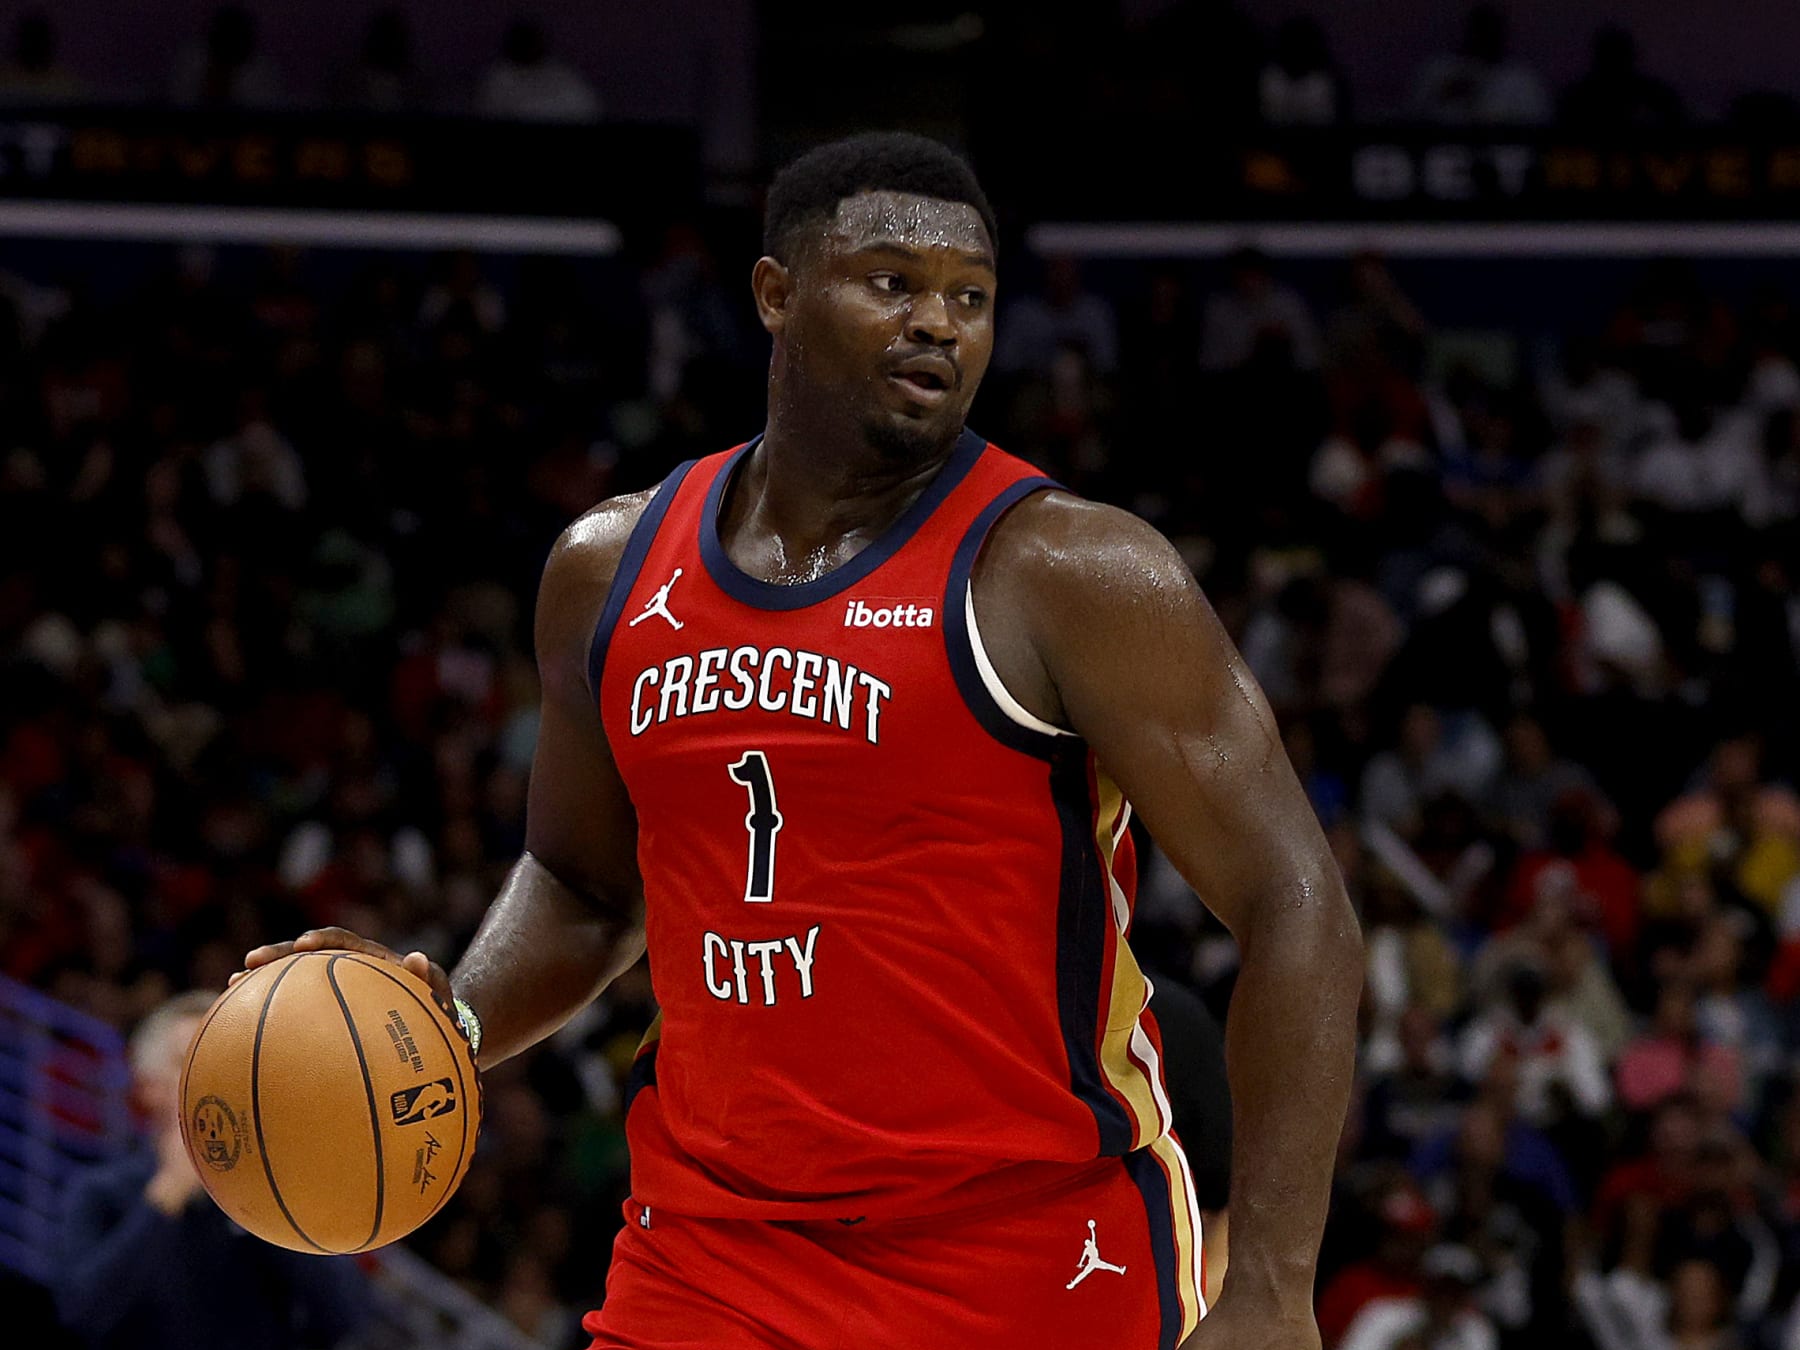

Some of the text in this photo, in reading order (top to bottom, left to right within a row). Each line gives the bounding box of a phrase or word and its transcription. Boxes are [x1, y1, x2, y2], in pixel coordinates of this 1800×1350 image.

[844, 601, 933, 627] ibotta
[630, 645, 892, 744] CRESCENT
[727, 750, 783, 902] 1
[703, 924, 820, 1006] CITY
[411, 1055, 424, 1074] BALL
[393, 1094, 409, 1114] NBA
